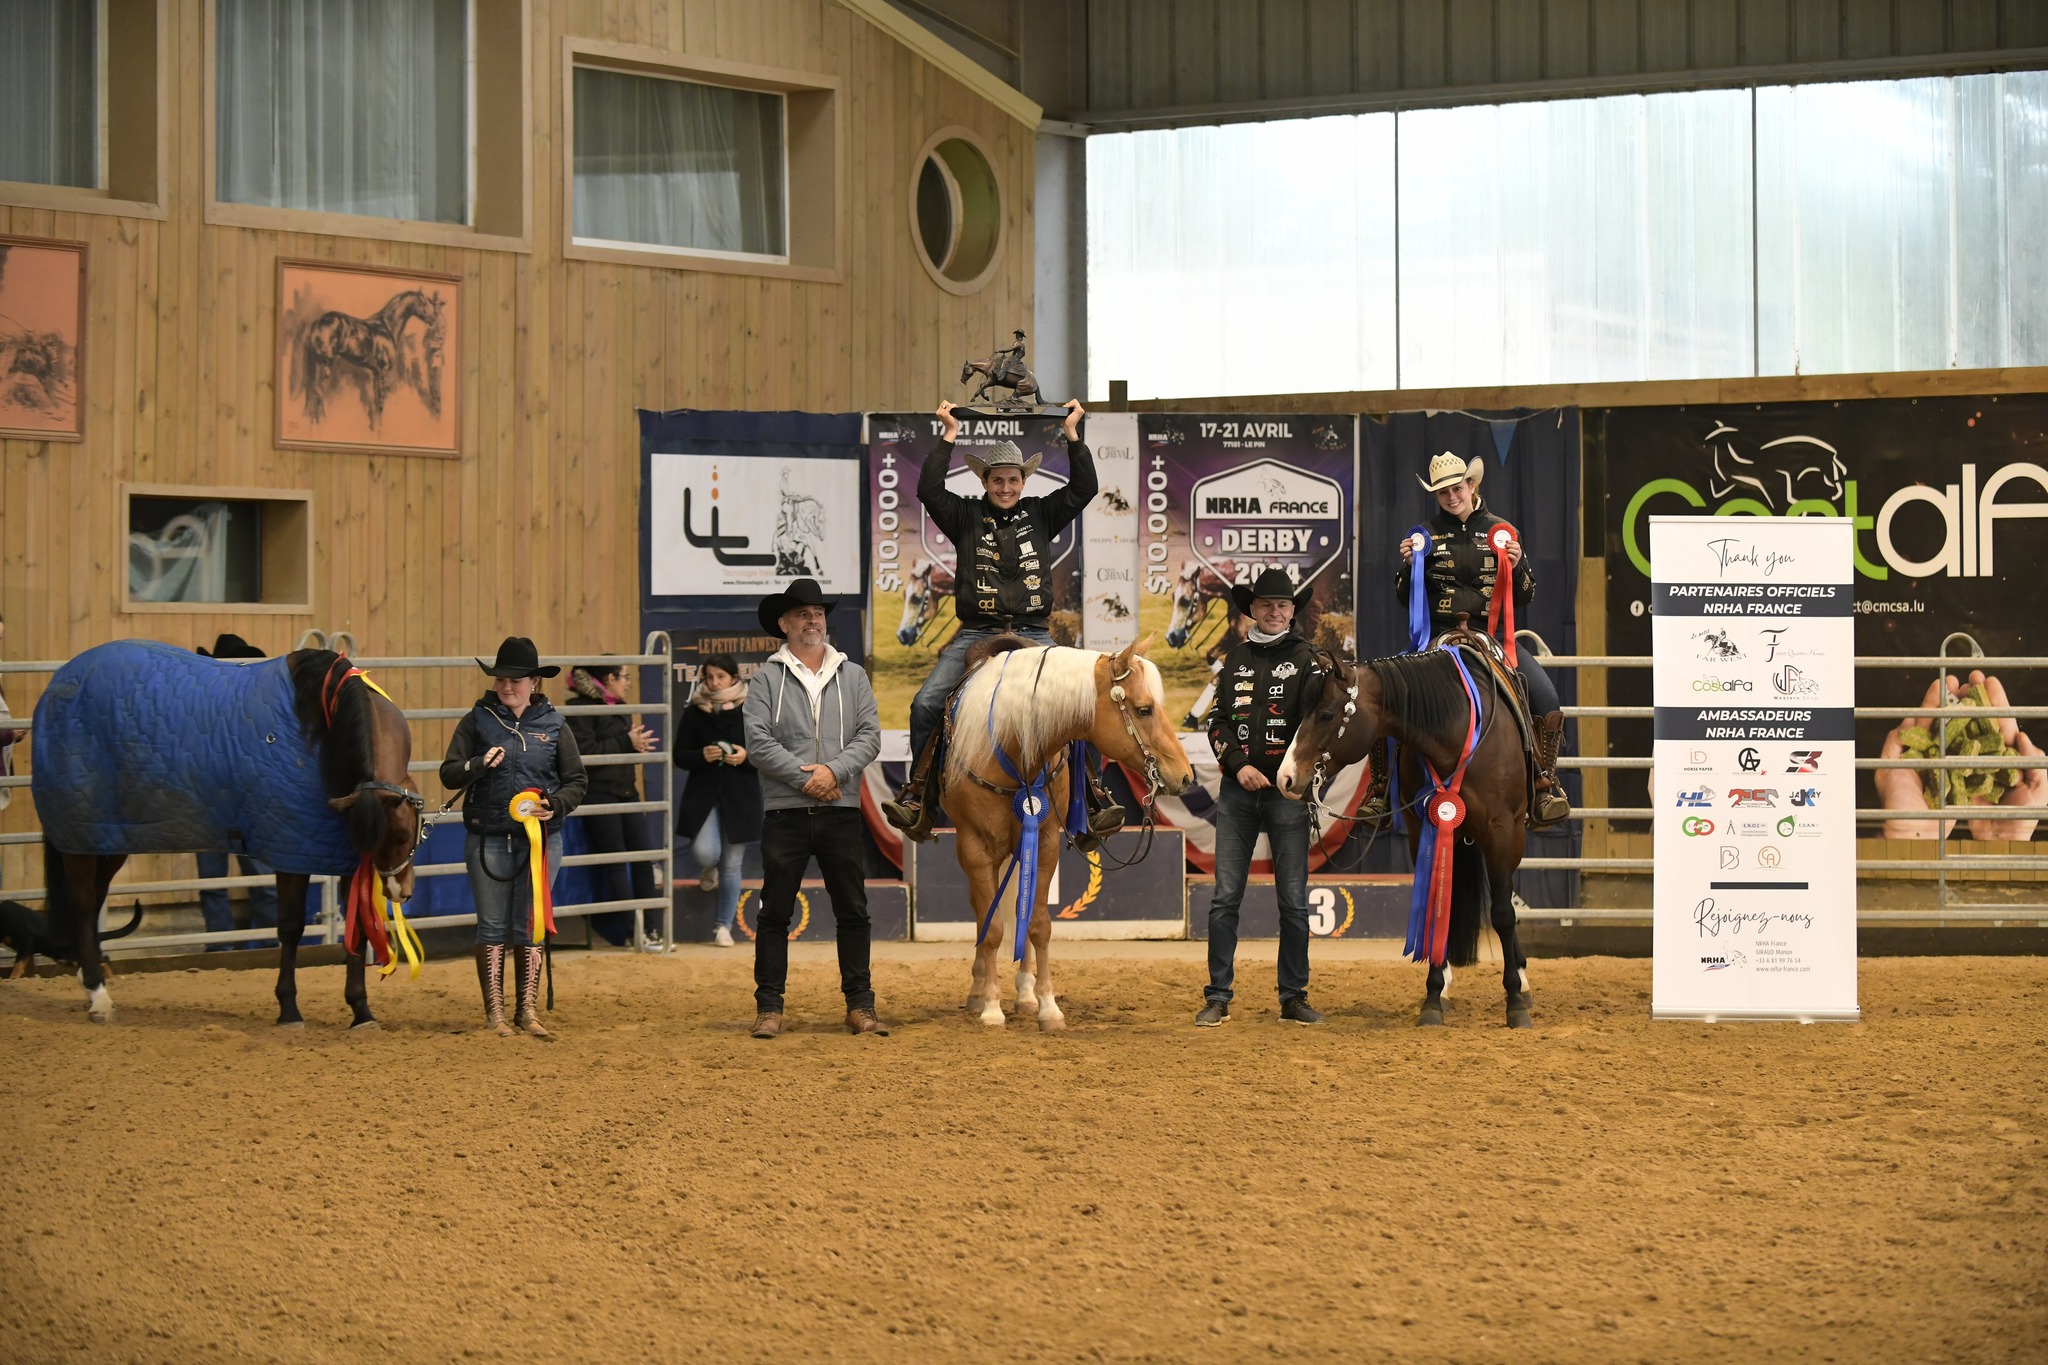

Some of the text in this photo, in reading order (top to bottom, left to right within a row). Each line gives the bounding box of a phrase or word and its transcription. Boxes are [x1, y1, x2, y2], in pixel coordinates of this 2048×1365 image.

[973, 421, 1024, 436] AVRIL
[1200, 423, 1294, 438] 17-21 AVRIL
[1206, 497, 1329, 514] NRHA FRANCE
[876, 453, 904, 593] $10.000+
[1144, 455, 1172, 595] $10.000+
[1221, 529, 1313, 552] DERBY
[1707, 539, 1795, 577] Thank you
[1669, 586, 1836, 597] PARTENAIRES OFFICIELS
[1704, 603, 1802, 614] NRHA FRANCE
[698, 636, 782, 654] LE PETIT FARWEST
[1692, 679, 1753, 691] Costalfa
[1697, 710, 1812, 721] AMBASSADEURS
[1705, 727, 1805, 738] NRHA FRANCE
[1308, 888, 1336, 935] 3
[1694, 897, 1815, 938] Rejoignez-nous
